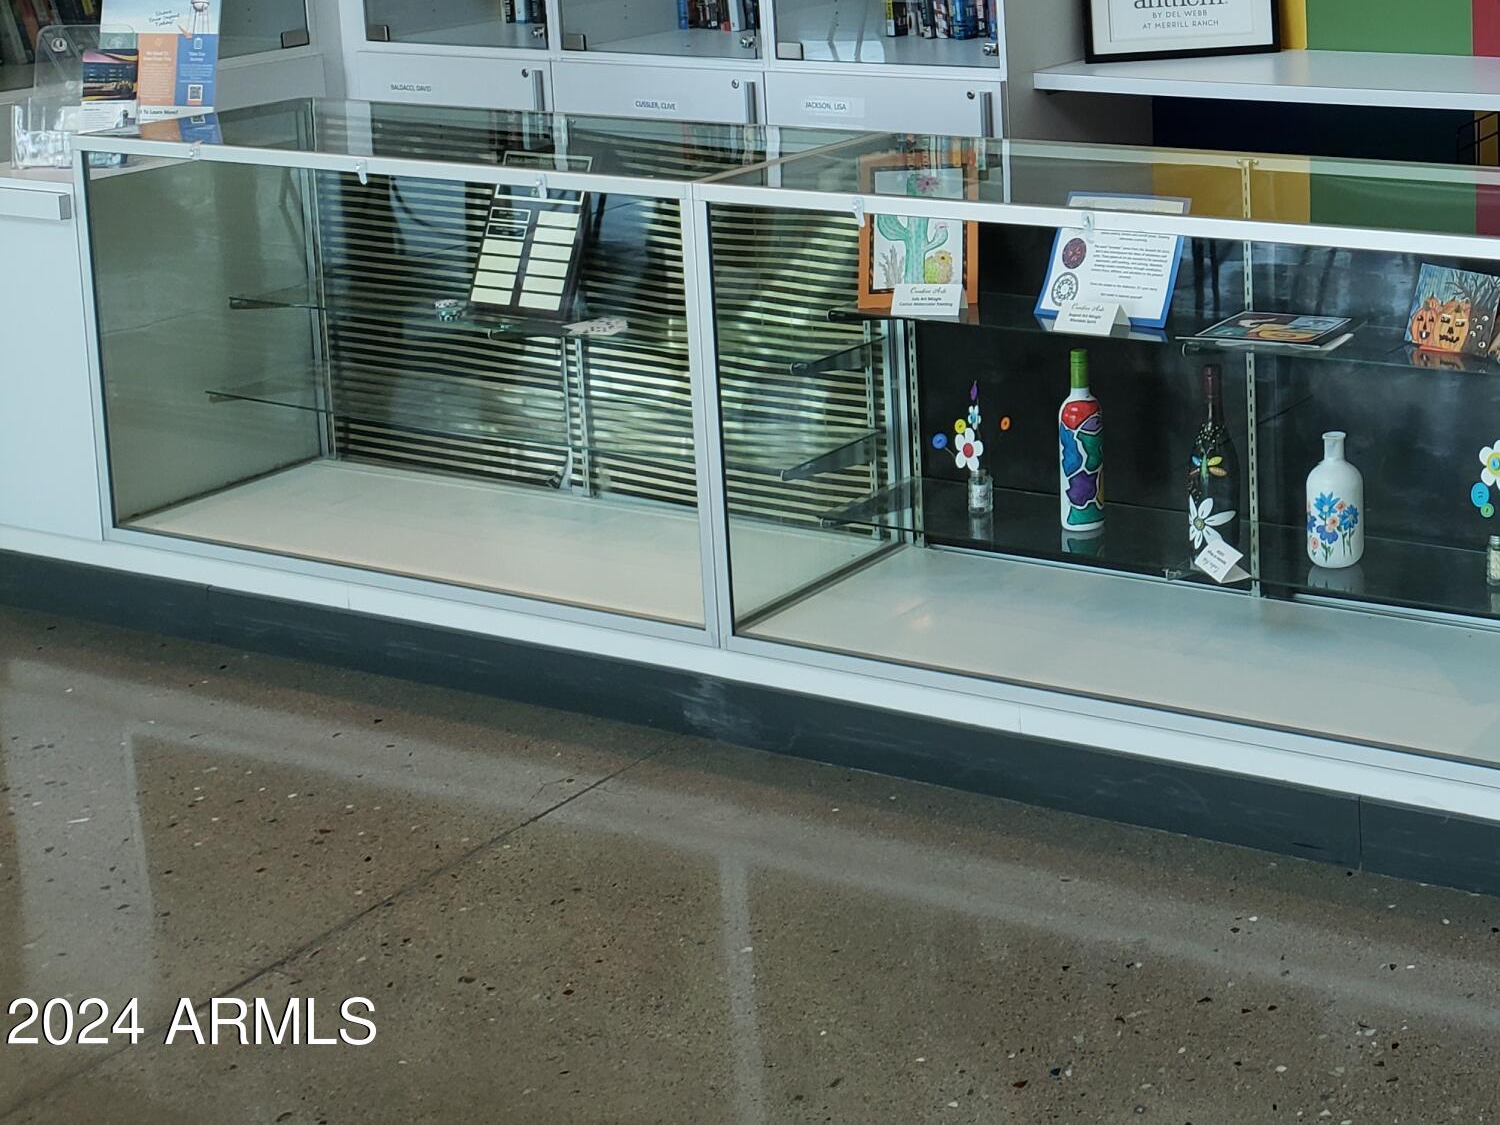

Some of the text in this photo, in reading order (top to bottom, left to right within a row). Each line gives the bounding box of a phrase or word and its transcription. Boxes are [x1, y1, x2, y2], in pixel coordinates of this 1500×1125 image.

[1152, 9, 1208, 19] BY DEL WEBB
[1142, 19, 1219, 29] AT MERRILL RANCH
[661, 102, 676, 110] CLIVE
